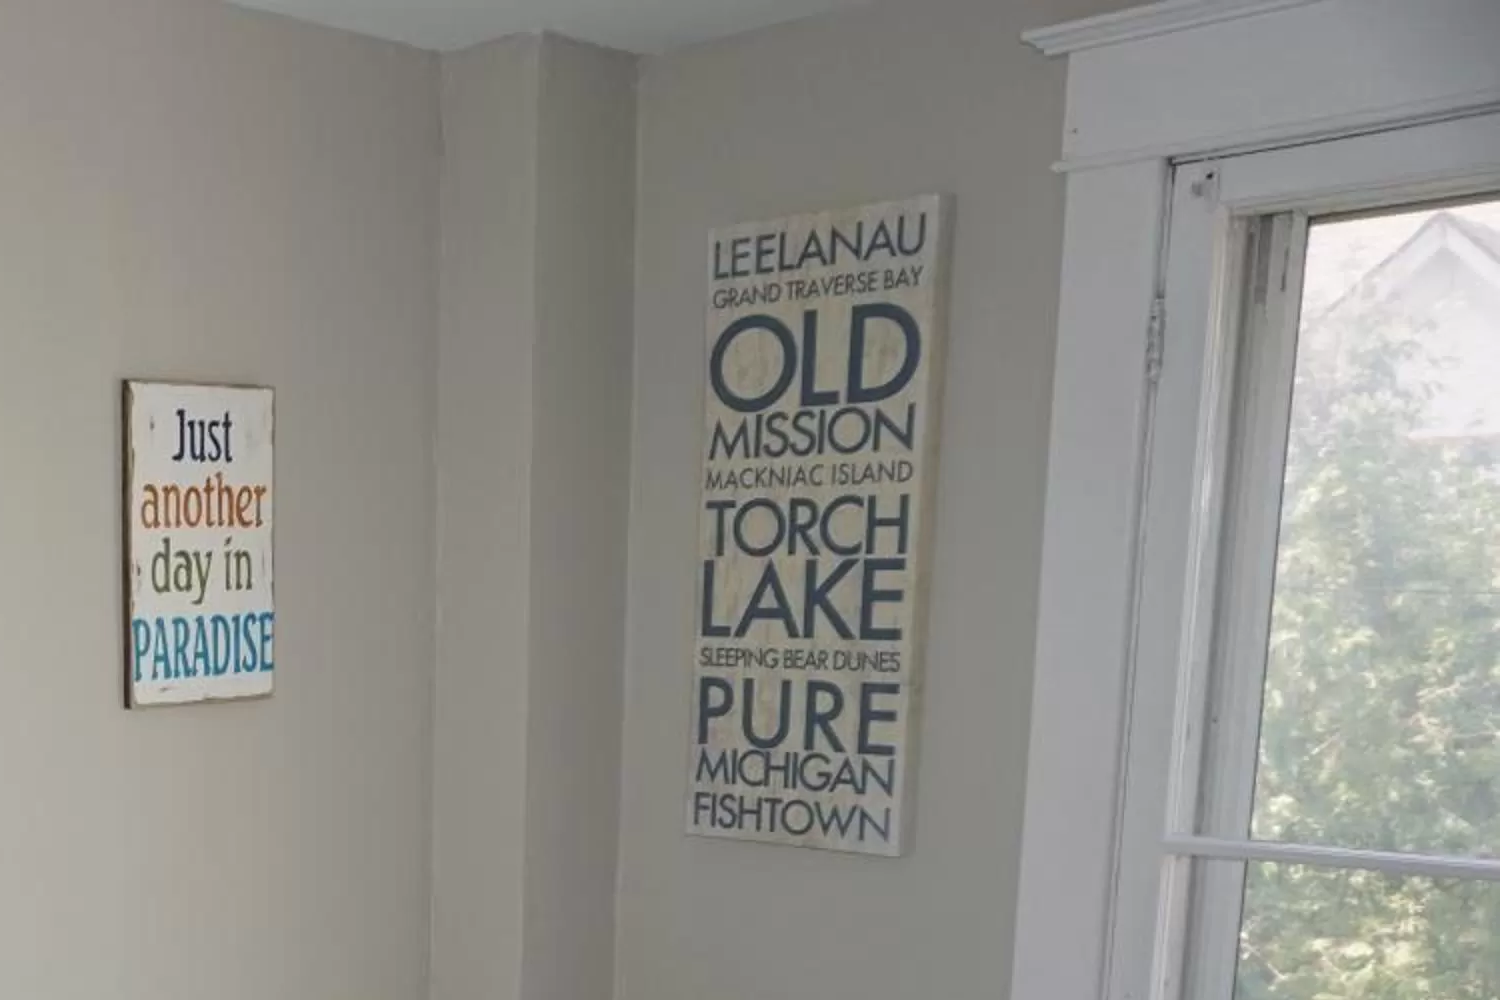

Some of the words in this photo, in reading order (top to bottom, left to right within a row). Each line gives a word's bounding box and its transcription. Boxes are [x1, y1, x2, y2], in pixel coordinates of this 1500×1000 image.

[714, 213, 926, 280] LEELANAU
[713, 281, 782, 309] GRAND
[787, 272, 878, 299] TRAVERSE
[884, 265, 925, 288] BAY
[709, 302, 921, 413] OLD
[171, 409, 234, 463] Just
[708, 402, 916, 461] MISSION
[140, 471, 267, 529] another
[705, 464, 824, 490] MACKNIAC
[831, 460, 914, 486] ISLAND
[705, 494, 910, 557] TORCH
[151, 537, 212, 605] day
[223, 535, 253, 591] in
[701, 558, 907, 641] LAKE
[131, 611, 275, 682] PARADISE
[699, 646, 778, 669] SLEEPING
[782, 650, 829, 670] BEAR
[832, 651, 901, 673] DUNES
[697, 676, 901, 756] PURE
[695, 748, 895, 797] MICHIGAN
[693, 792, 891, 842] FISHTOWN
